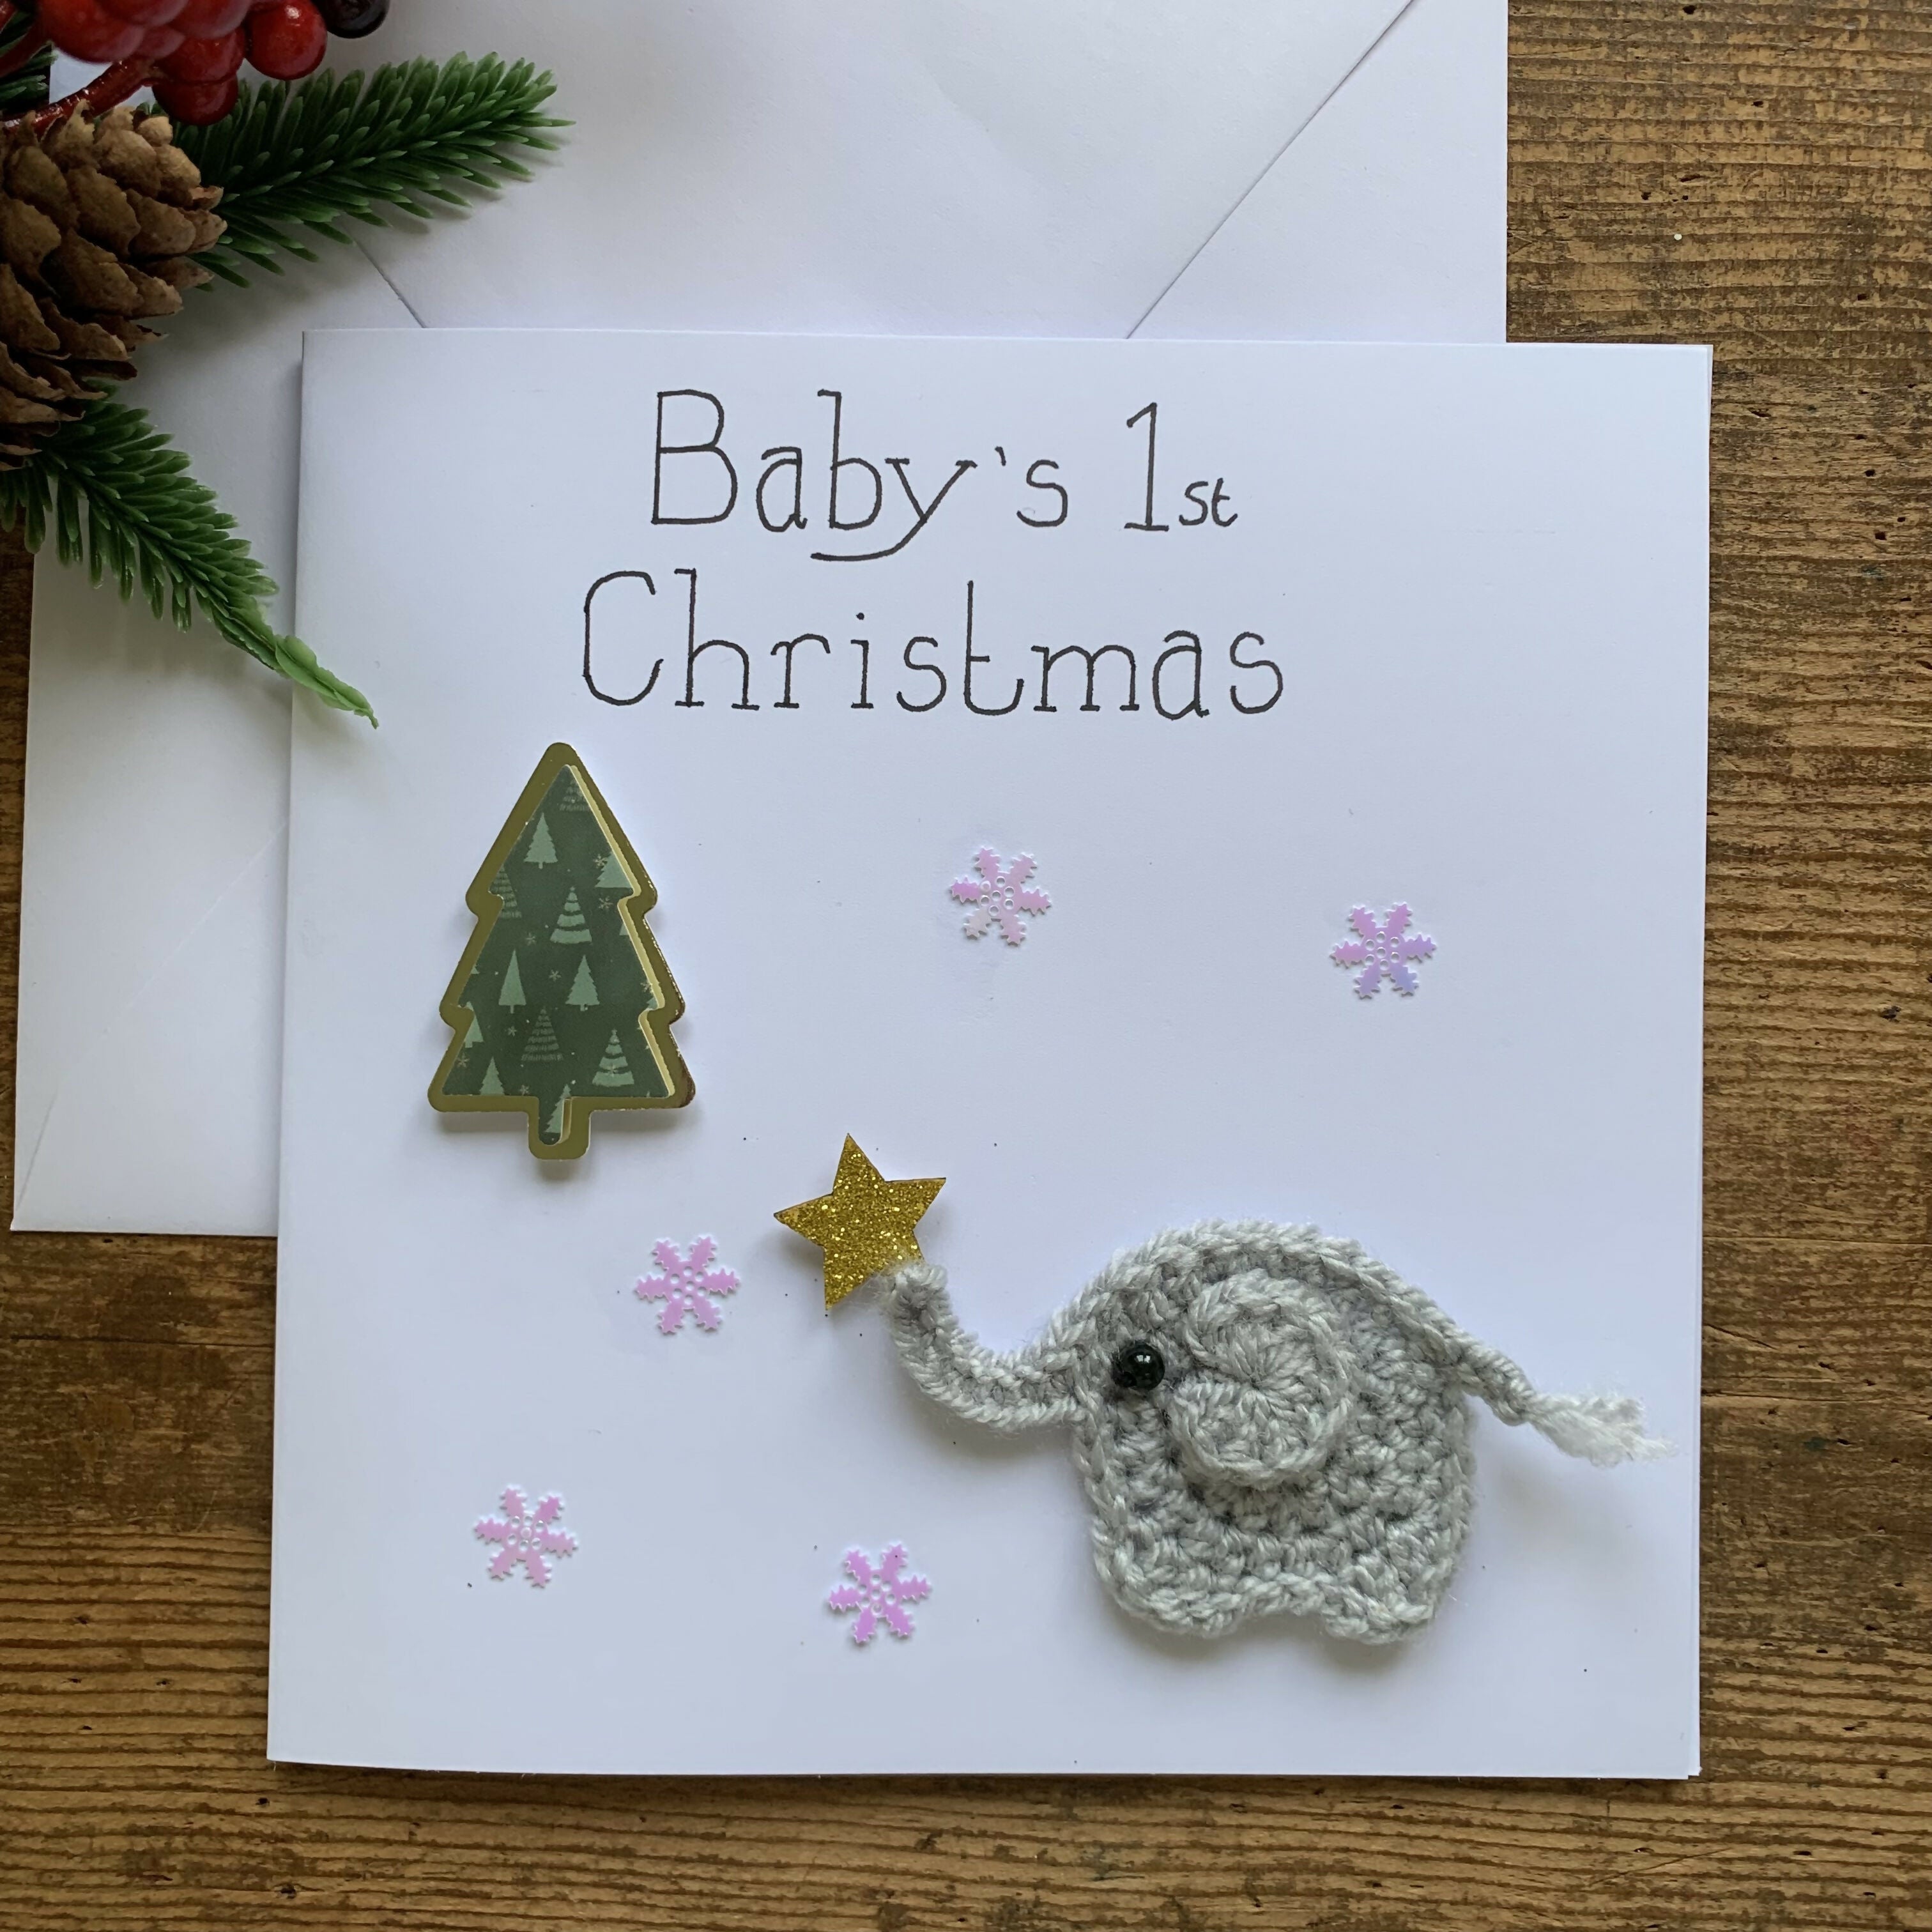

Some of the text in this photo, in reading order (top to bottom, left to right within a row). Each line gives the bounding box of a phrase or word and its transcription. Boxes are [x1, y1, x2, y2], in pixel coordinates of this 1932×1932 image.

[651, 389, 1238, 562] Baby's 1st
[582, 568, 1283, 721] Christmas
